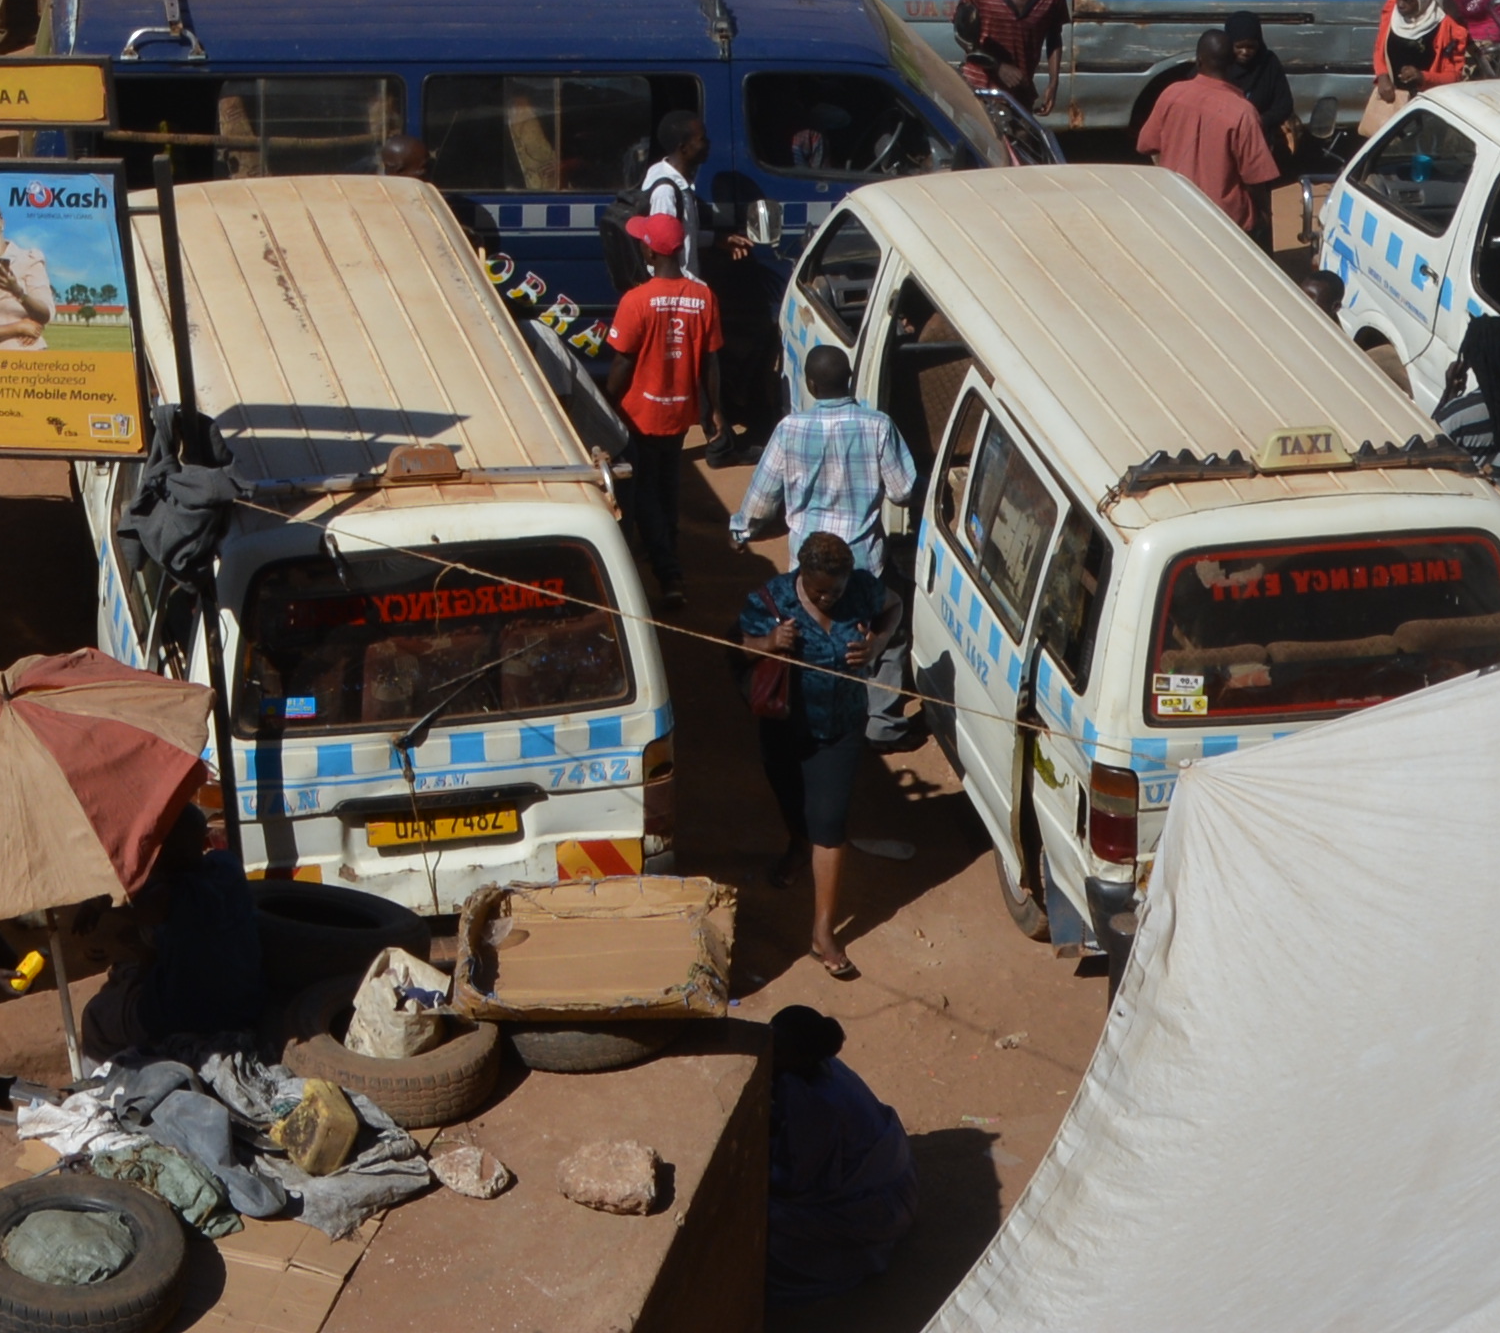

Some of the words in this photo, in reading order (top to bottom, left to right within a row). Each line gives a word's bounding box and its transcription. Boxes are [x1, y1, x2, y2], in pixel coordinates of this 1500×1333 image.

[16, 89, 30, 105] A
[10, 358, 73, 372] okutereka
[74, 360, 96, 372] oba
[22, 387, 69, 402] Mobile
[69, 389, 118, 404] Money.
[1275, 432, 1333, 457] TAXI
[395, 818, 437, 840] UAN
[450, 812, 504, 836] 748Z
